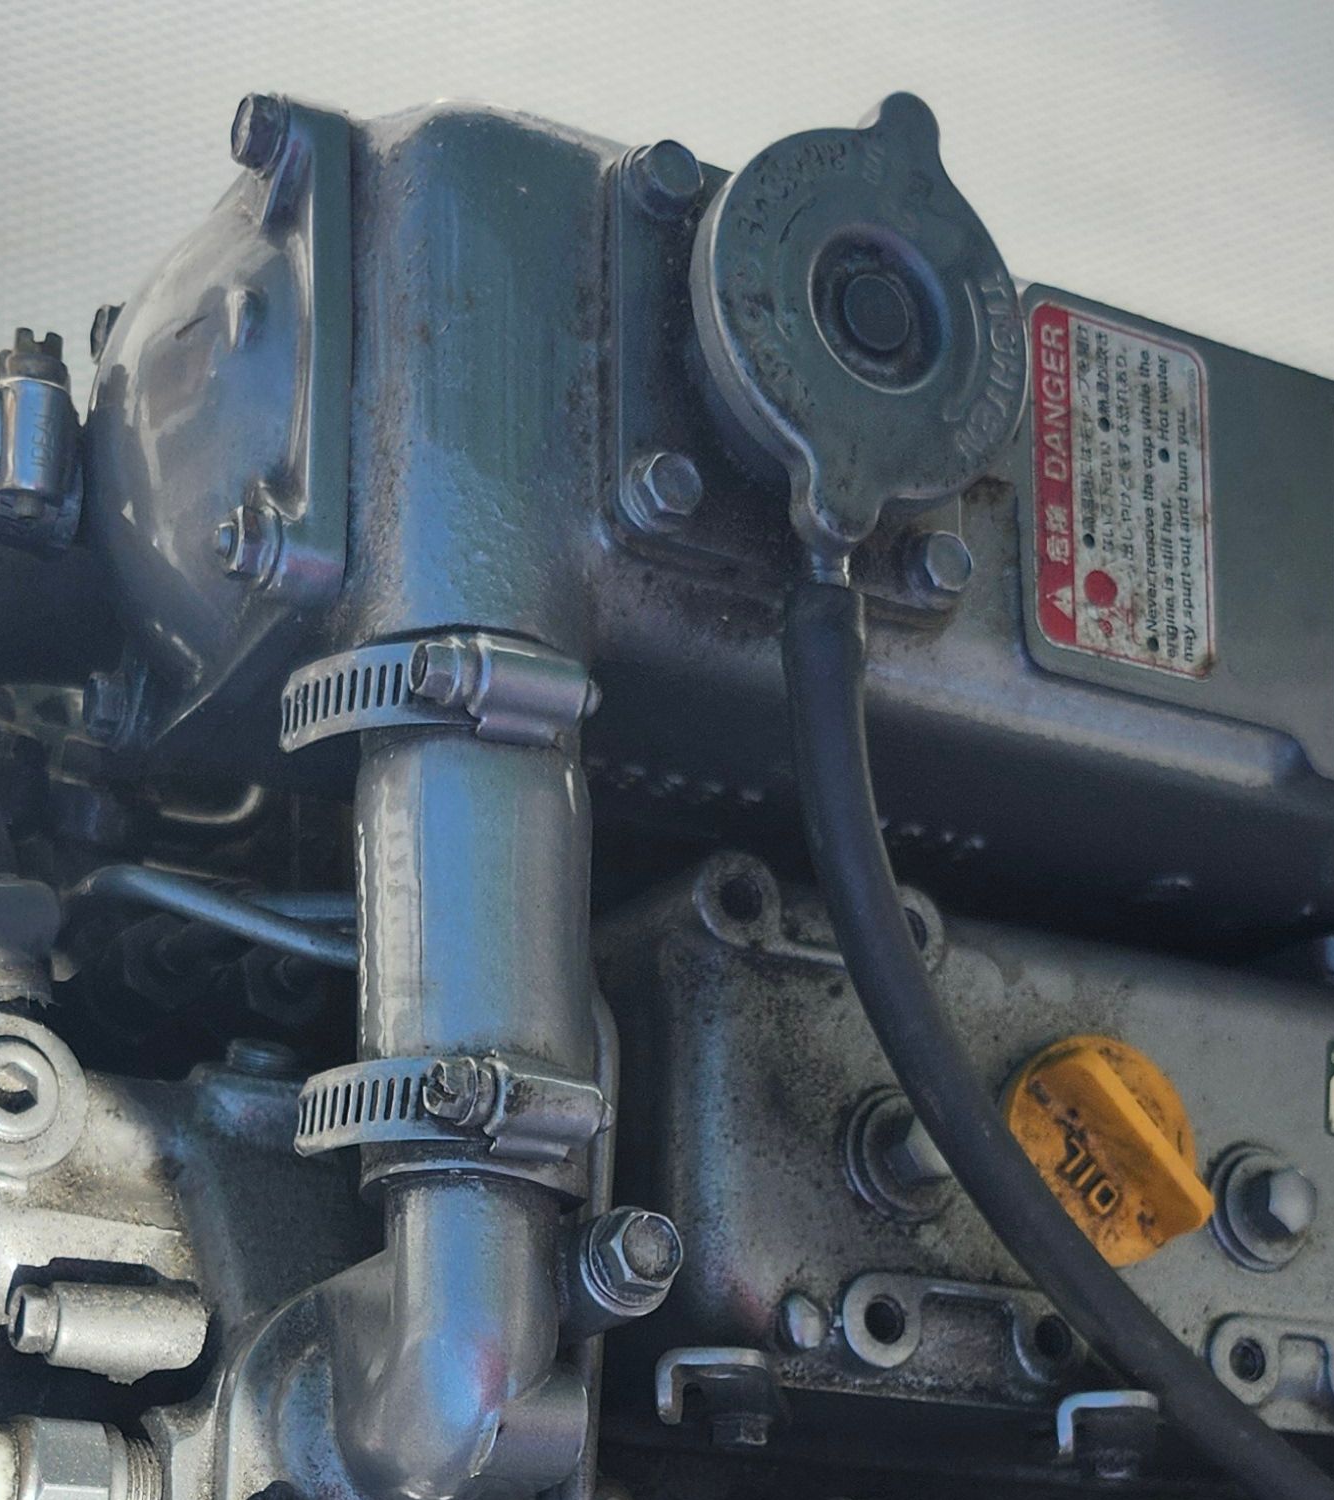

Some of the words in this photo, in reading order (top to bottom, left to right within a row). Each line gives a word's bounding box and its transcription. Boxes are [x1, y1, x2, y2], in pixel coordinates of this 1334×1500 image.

[1138, 348, 1151, 379] the
[1156, 354, 1169, 404] water
[1040, 319, 1068, 483] DANGER
[1139, 382, 1152, 431] while
[1156, 406, 1169, 442] Hot
[1142, 435, 1157, 470] cap
[1176, 448, 1188, 493] burn
[1142, 473, 1154, 502] the
[1177, 496, 1189, 532] and
[1144, 506, 1156, 576] remove
[1160, 535, 1173, 570] still
[1179, 535, 1191, 567] out
[1162, 574, 1173, 592] is
[1179, 570, 1194, 619] spurt
[1145, 580, 1157, 632] Never
[1163, 595, 1178, 659] engine
[1181, 623, 1196, 664] may
[1065, 1137, 1119, 1215] OIL
